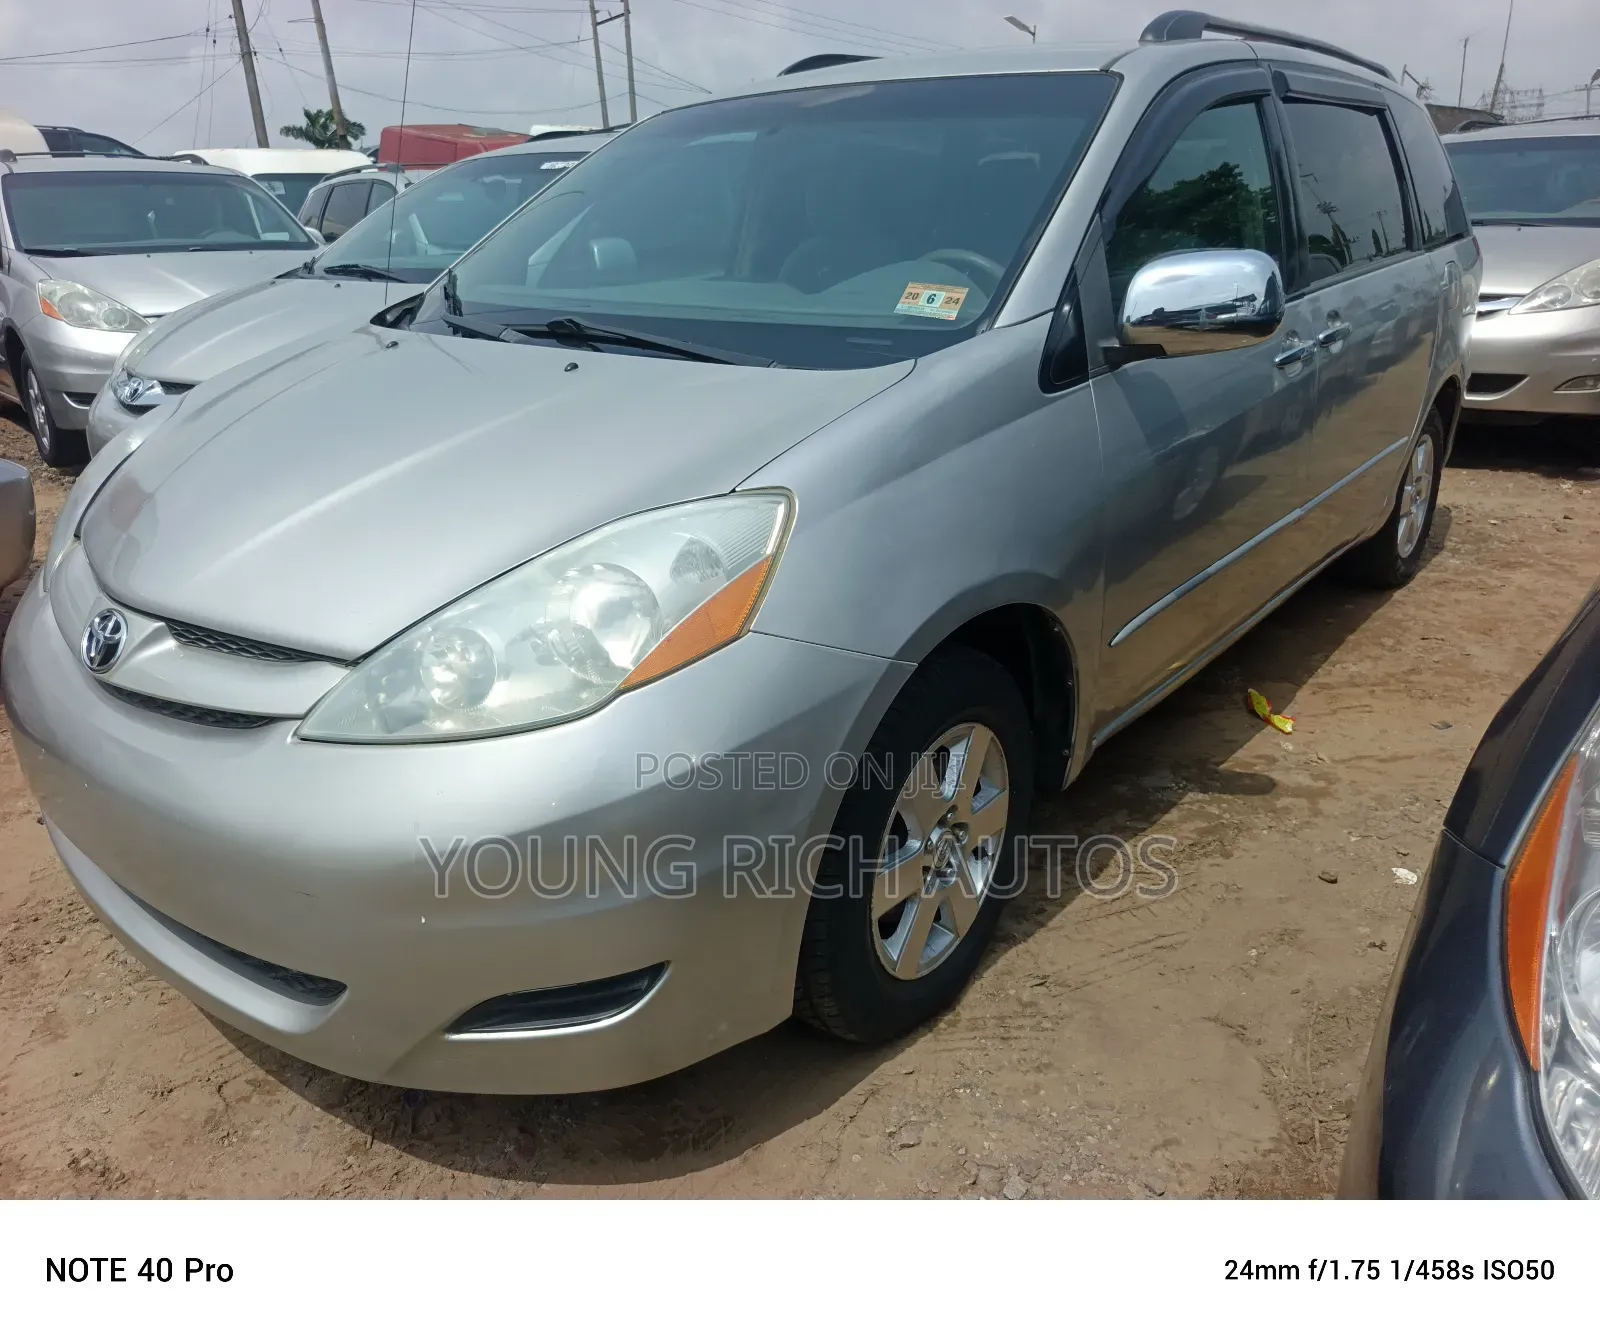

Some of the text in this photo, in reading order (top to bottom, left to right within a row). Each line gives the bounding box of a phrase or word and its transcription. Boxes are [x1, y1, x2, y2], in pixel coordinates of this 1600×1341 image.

[904, 291, 961, 306] 20 6 24
